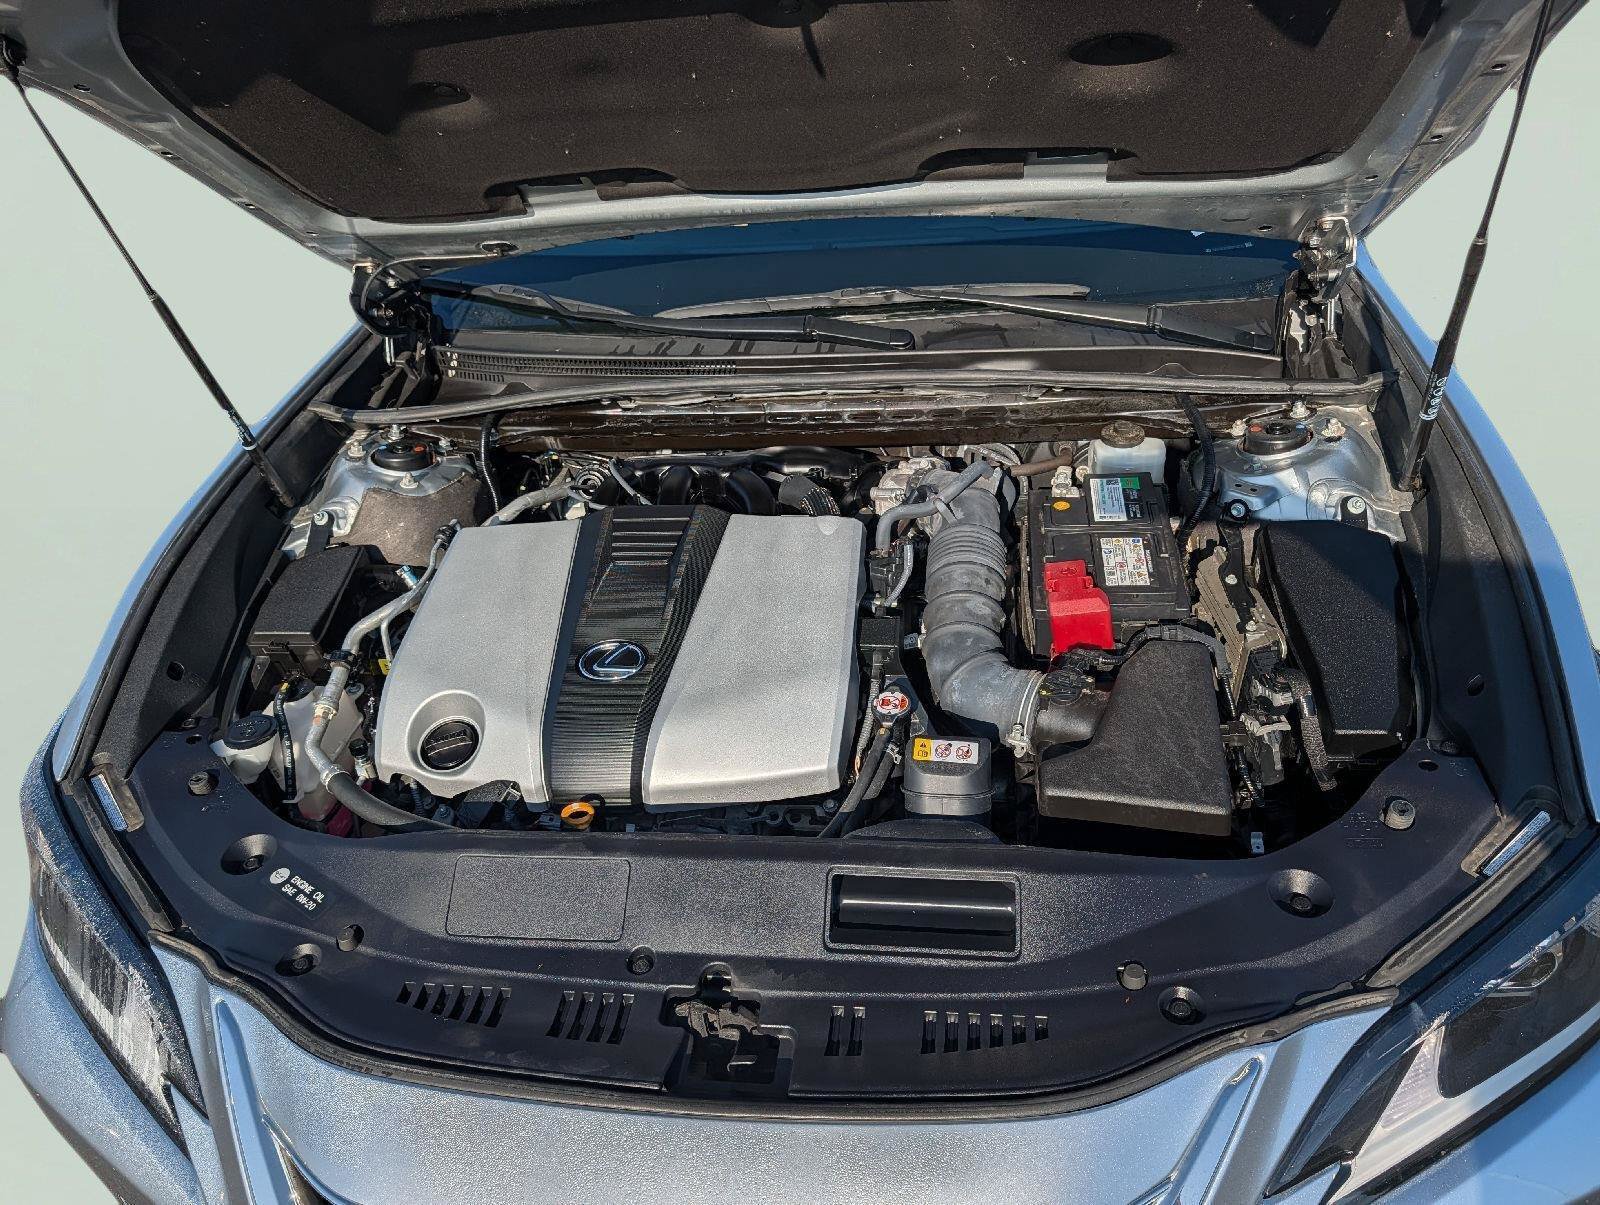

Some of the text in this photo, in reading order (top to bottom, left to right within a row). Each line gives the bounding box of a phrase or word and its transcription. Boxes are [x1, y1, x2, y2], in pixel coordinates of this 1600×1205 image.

[281, 883, 317, 911] SAE 0W-20
[290, 875, 325, 903] ENGINE OIL
